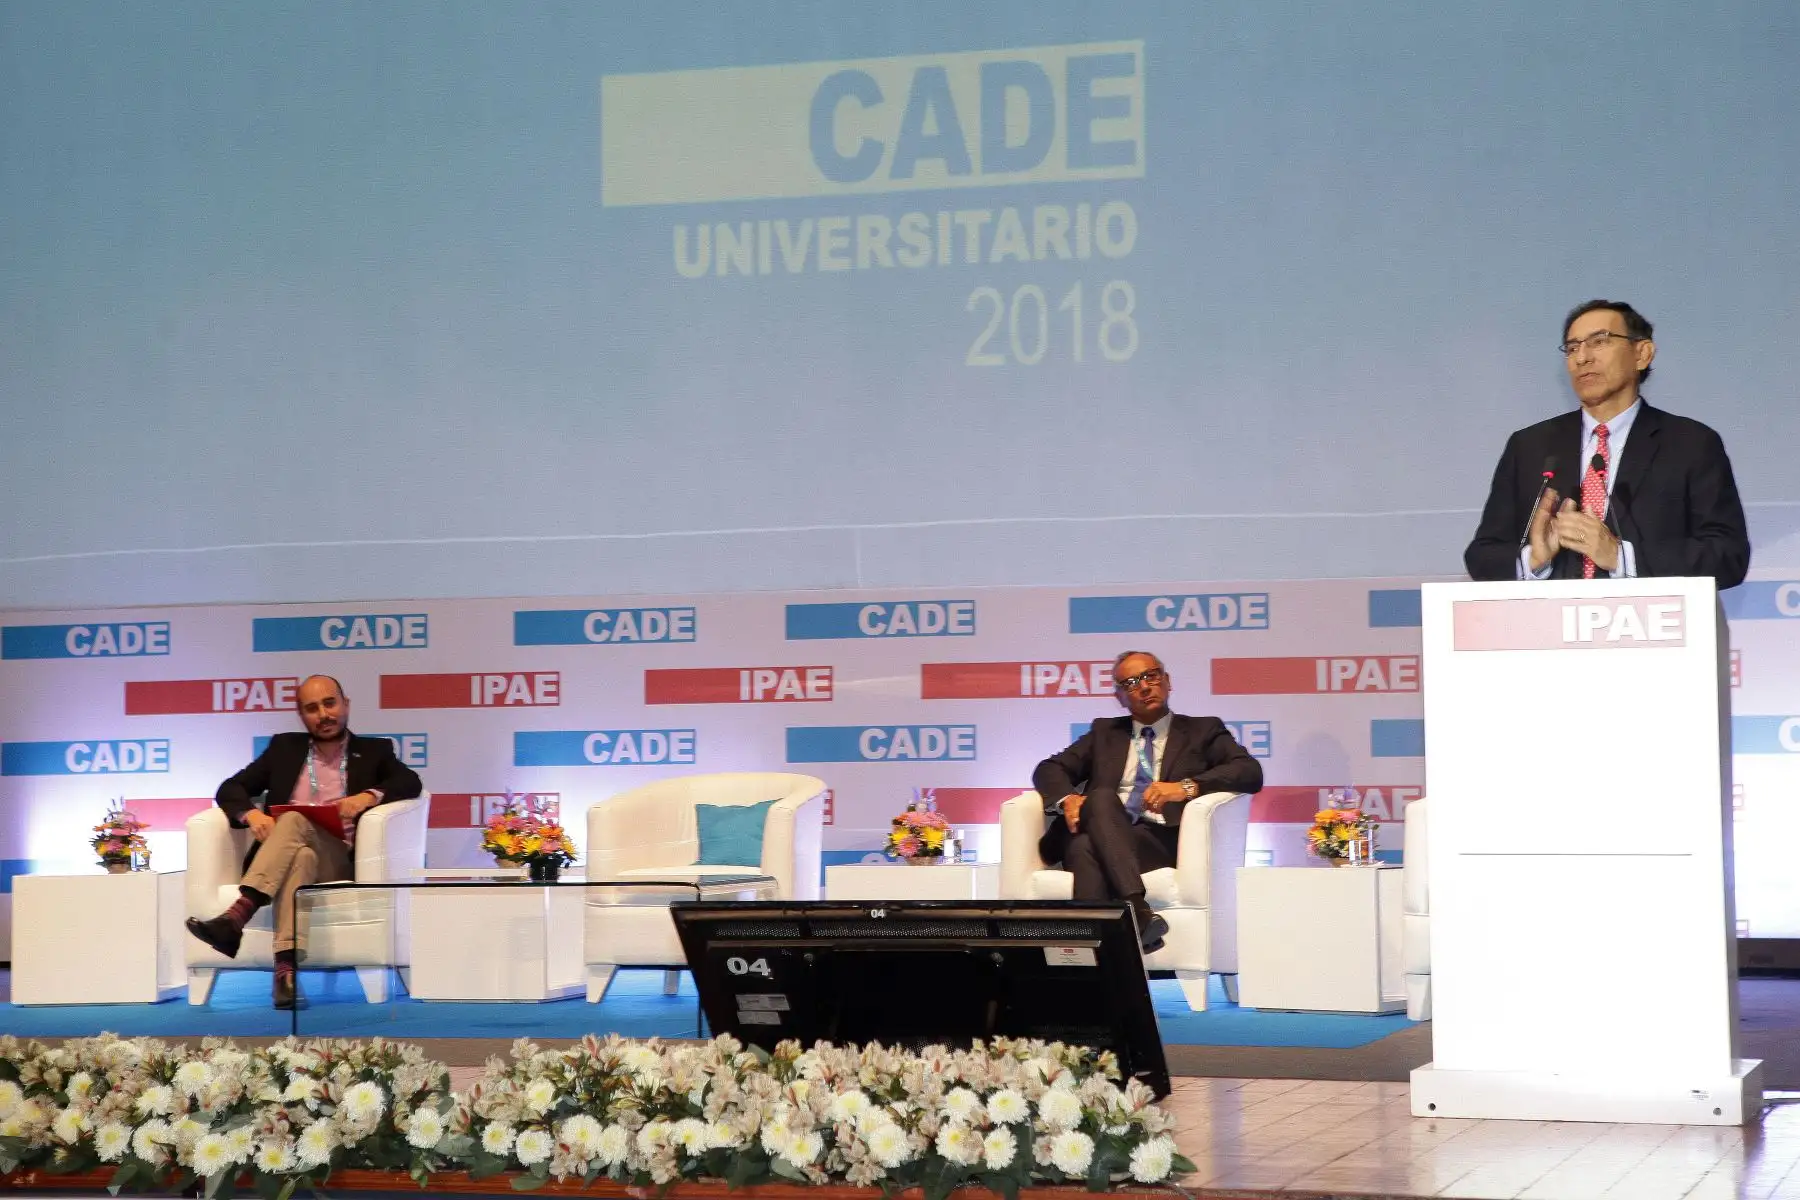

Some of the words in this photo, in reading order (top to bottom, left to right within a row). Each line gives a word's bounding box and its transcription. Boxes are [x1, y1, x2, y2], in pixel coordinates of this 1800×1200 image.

[808, 52, 1138, 184] CADE
[673, 200, 1138, 278] UNIVERSITARIO
[964, 279, 1140, 367] 2018
[583, 609, 694, 642] CADE
[857, 602, 974, 636] CADE
[1146, 595, 1267, 631] CADE
[1561, 602, 1683, 643] IPAE
[66, 623, 169, 656] CADE
[320, 615, 426, 648] CADE
[470, 673, 558, 706] IPAE
[739, 668, 831, 701] IPAE
[1020, 663, 1114, 696] IPAE
[1315, 657, 1418, 692] IPAE
[212, 678, 299, 711] IPAE
[66, 741, 169, 773] CADE
[583, 732, 693, 764] CADE
[858, 726, 974, 761] CADE
[470, 795, 559, 826] IP
[870, 909, 885, 918] 04
[726, 957, 771, 976] 04
